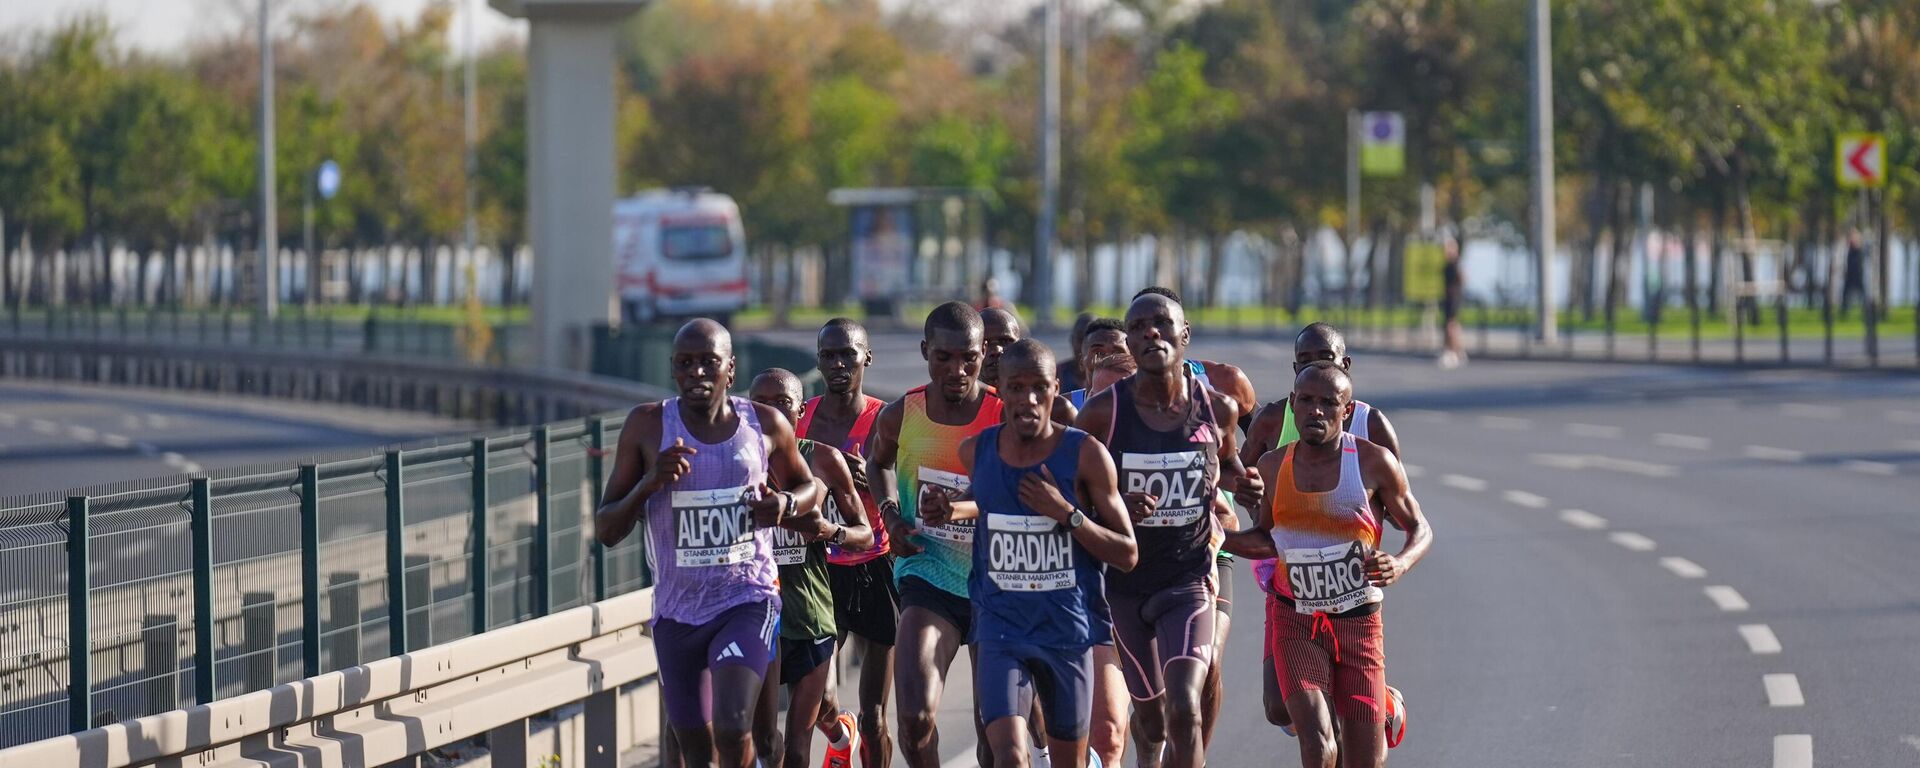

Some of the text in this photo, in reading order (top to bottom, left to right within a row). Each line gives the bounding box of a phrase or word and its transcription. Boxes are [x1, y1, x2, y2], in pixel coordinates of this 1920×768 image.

[1194, 456, 1205, 467] 94
[1128, 470, 1202, 508] BOAZ
[1161, 508, 1198, 518] MARATHON
[678, 504, 754, 548] ALFONCE
[683, 548, 715, 557] ISTANBUL
[772, 548, 801, 557] ARATHON
[990, 531, 1073, 572] OBADIAH
[997, 570, 1069, 582] ISTANBUL MARATHON
[1290, 558, 1364, 599] SUFARO
[1055, 579, 1071, 588] 2025
[1329, 589, 1366, 607] MARATHON
